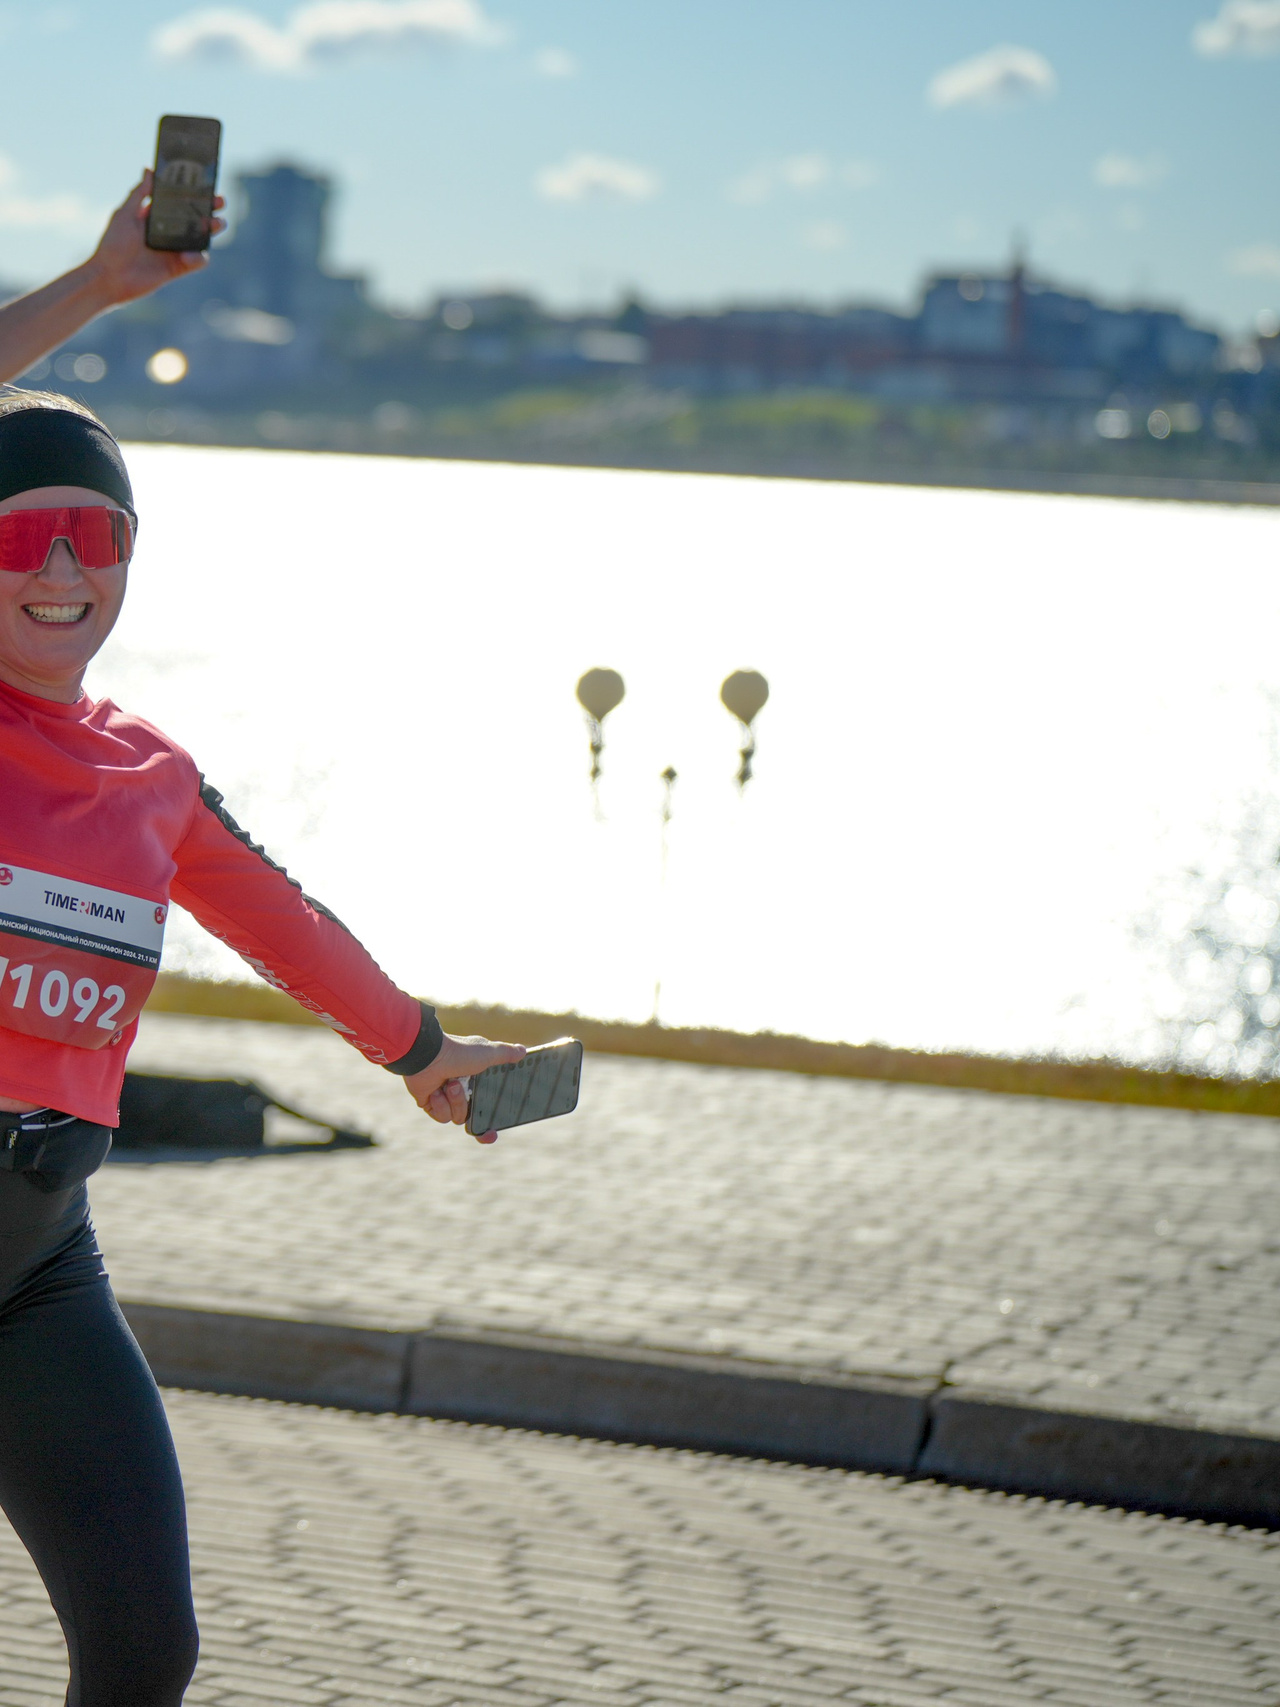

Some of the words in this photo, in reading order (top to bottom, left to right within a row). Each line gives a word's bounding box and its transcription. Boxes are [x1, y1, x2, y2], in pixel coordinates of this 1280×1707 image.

[29, 925, 79, 944] НАЦИОНАЛЬНЫЙ
[79, 938, 123, 955] ПОЛУМАРАФОН
[9, 963, 126, 1031] 1092
